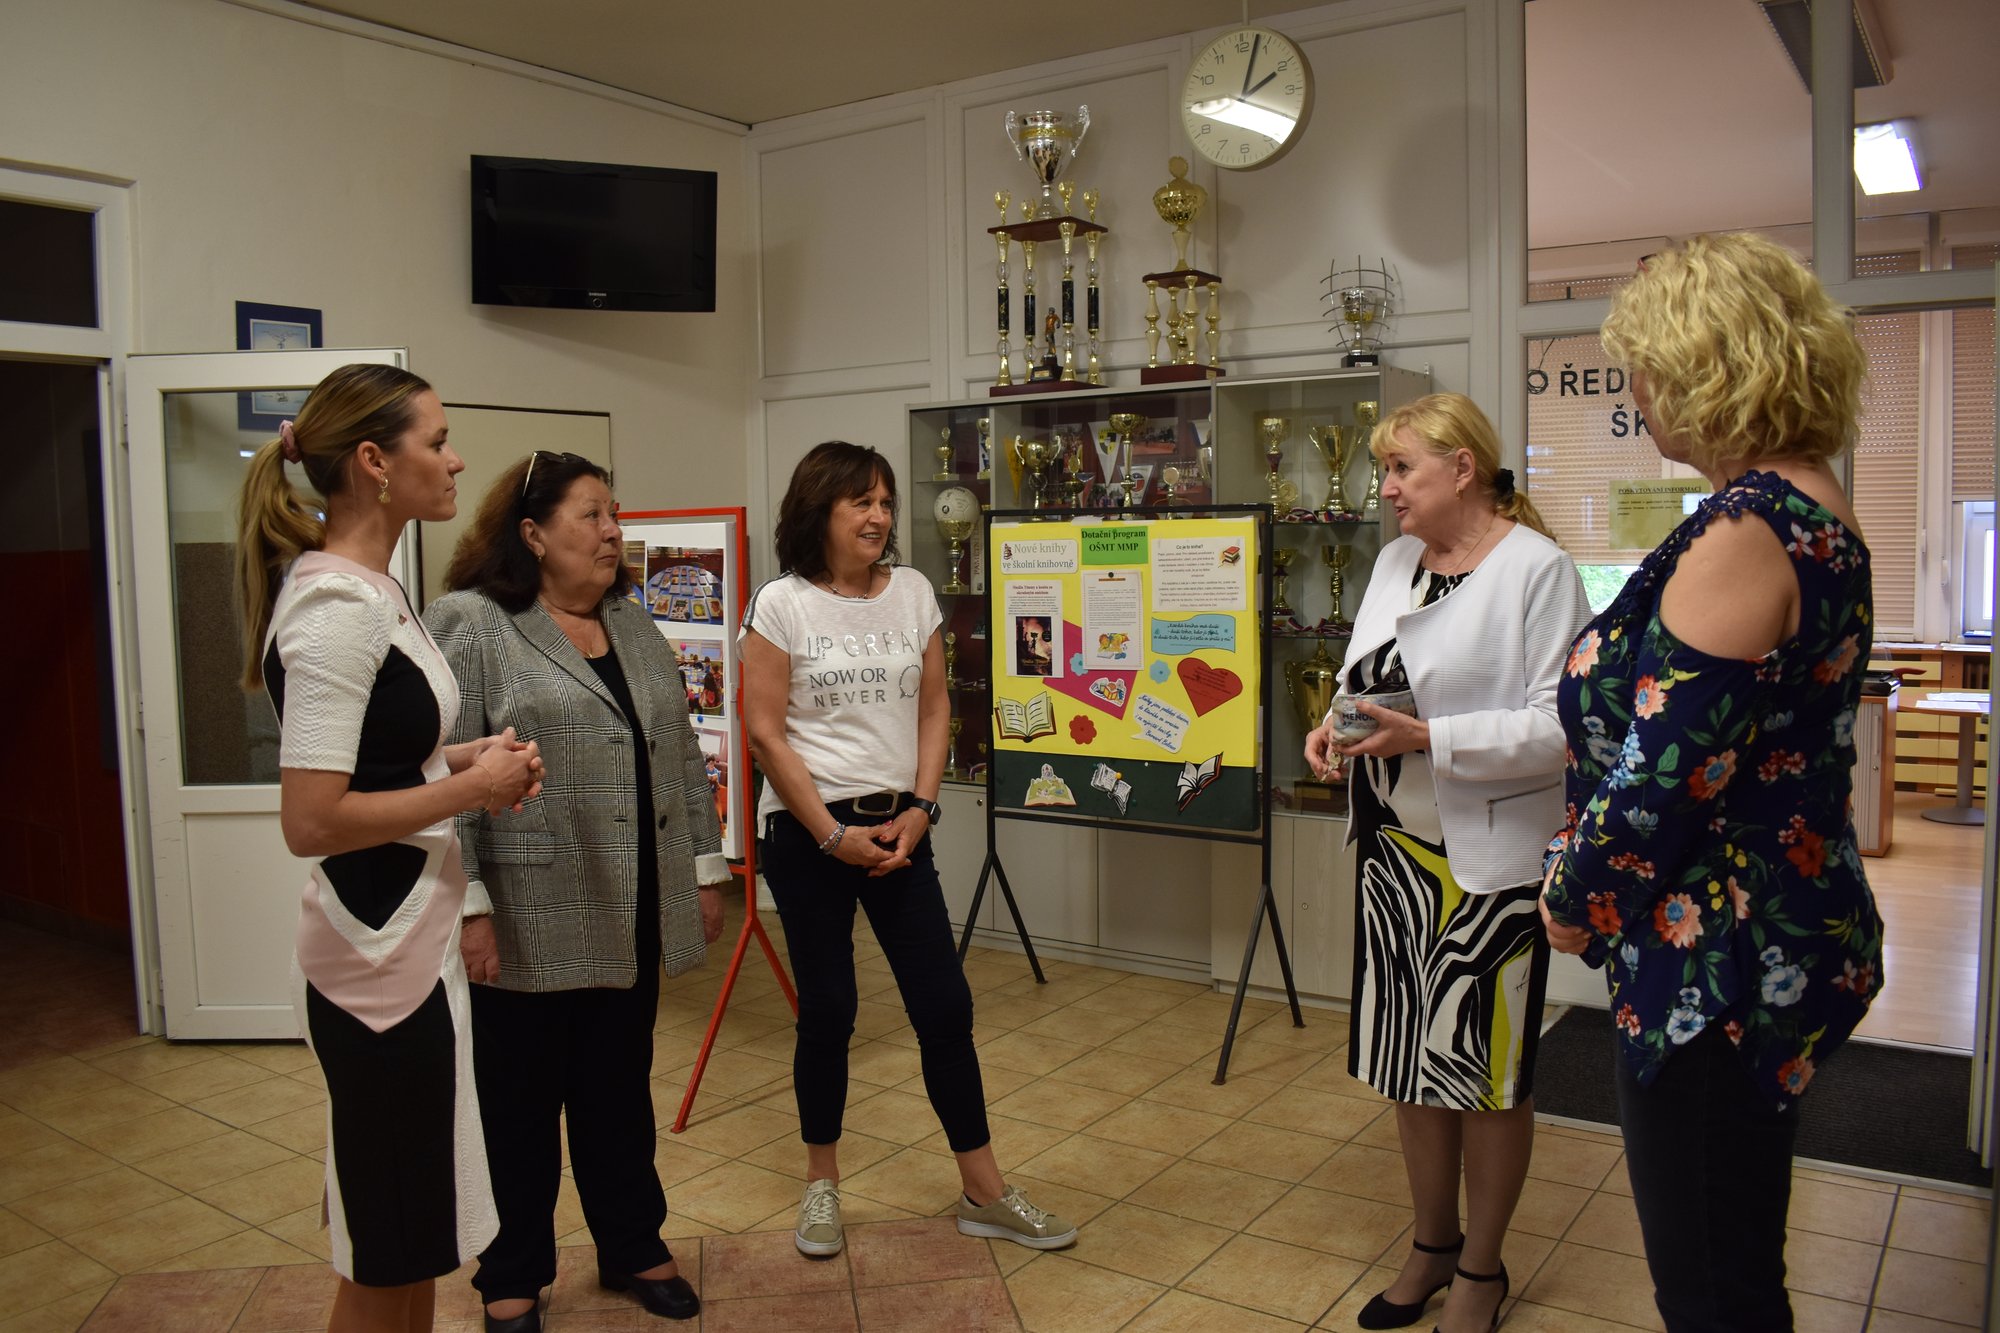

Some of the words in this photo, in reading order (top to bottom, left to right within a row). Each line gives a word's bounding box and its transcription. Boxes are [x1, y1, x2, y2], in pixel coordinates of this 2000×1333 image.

[1235, 42, 1250, 53] 12
[1262, 45, 1268, 55] 1
[1214, 54, 1225, 65] 11
[1277, 60, 1288, 72] 2
[1200, 74, 1215, 86] 10
[1284, 84, 1296, 96] 3
[1200, 124, 1211, 135] 8
[1218, 139, 1229, 150] 7
[1240, 143, 1250, 154] 6
[1082, 530, 1112, 539] Dotační
[1113, 530, 1146, 540] program
[1014, 543, 1038, 554] Nové
[1039, 542, 1068, 555] knihy
[1089, 542, 1116, 552] OŠMT
[1117, 542, 1139, 551] MMP
[1002, 561, 1011, 569] ve
[1012, 559, 1036, 569] školní
[1036, 559, 1074, 569] knihovně
[809, 669, 856, 689] NOW
[861, 667, 888, 683] OR
[814, 689, 887, 708] NEVER
